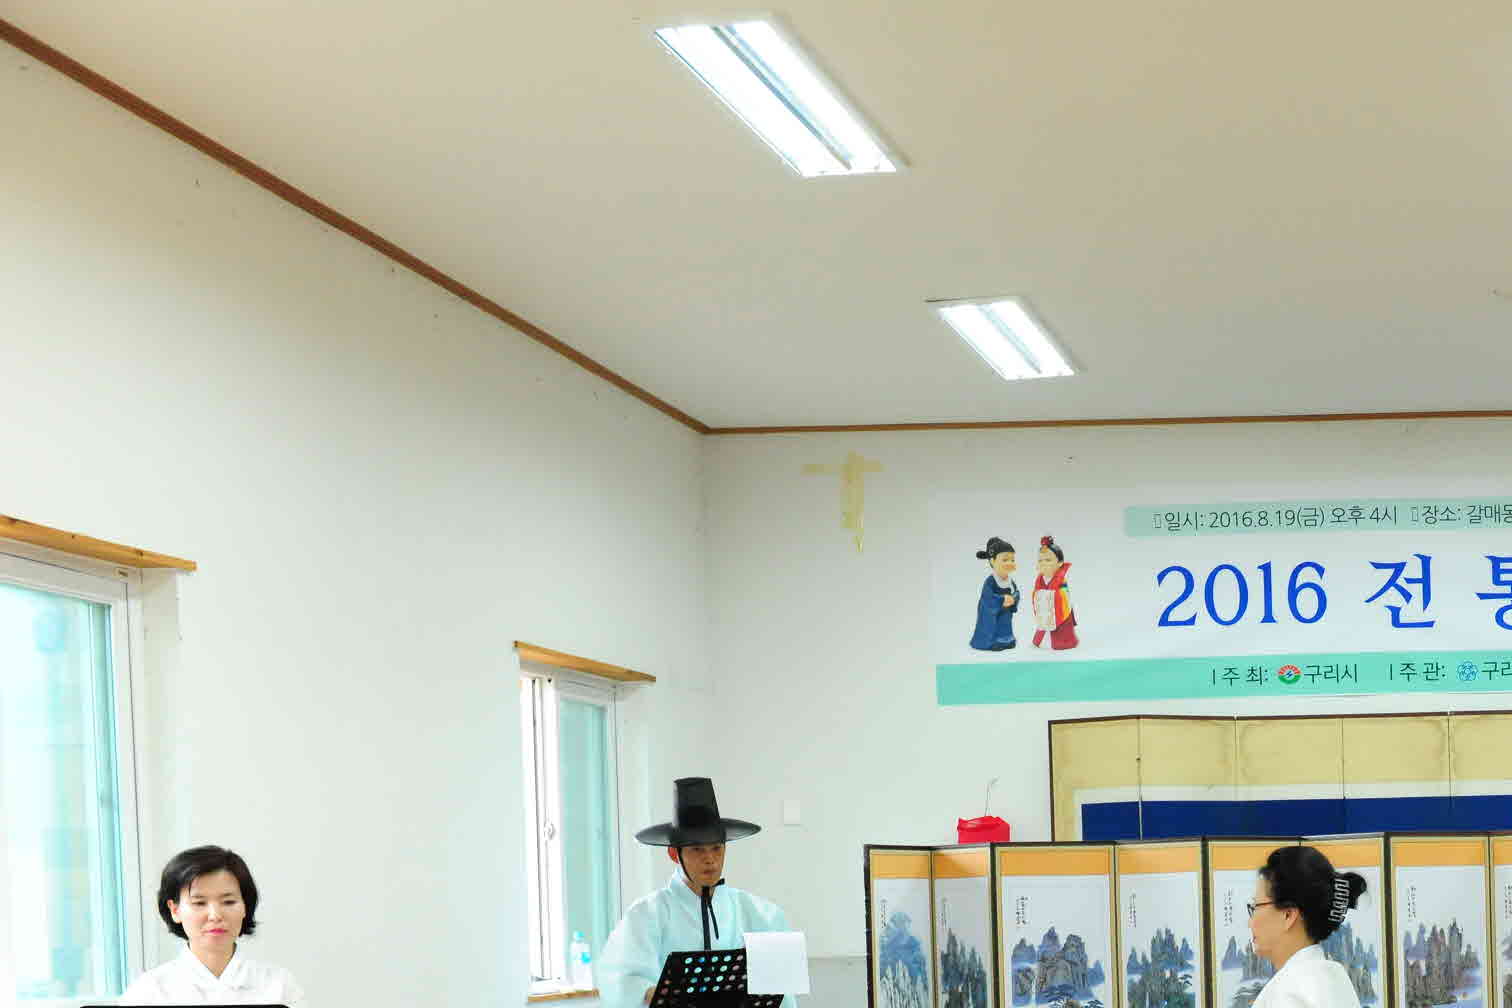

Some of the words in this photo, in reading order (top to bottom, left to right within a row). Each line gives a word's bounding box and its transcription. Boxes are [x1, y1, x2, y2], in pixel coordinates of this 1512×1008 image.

[1164, 511, 1205, 533] 일시:
[1209, 507, 1326, 528] 2016.8.19(금)
[1330, 507, 1366, 525] 오후
[1369, 505, 1398, 525] 4시
[1422, 503, 1461, 525] 장소:
[1156, 560, 1328, 627] 2016
[1303, 663, 1358, 684] 구리시
